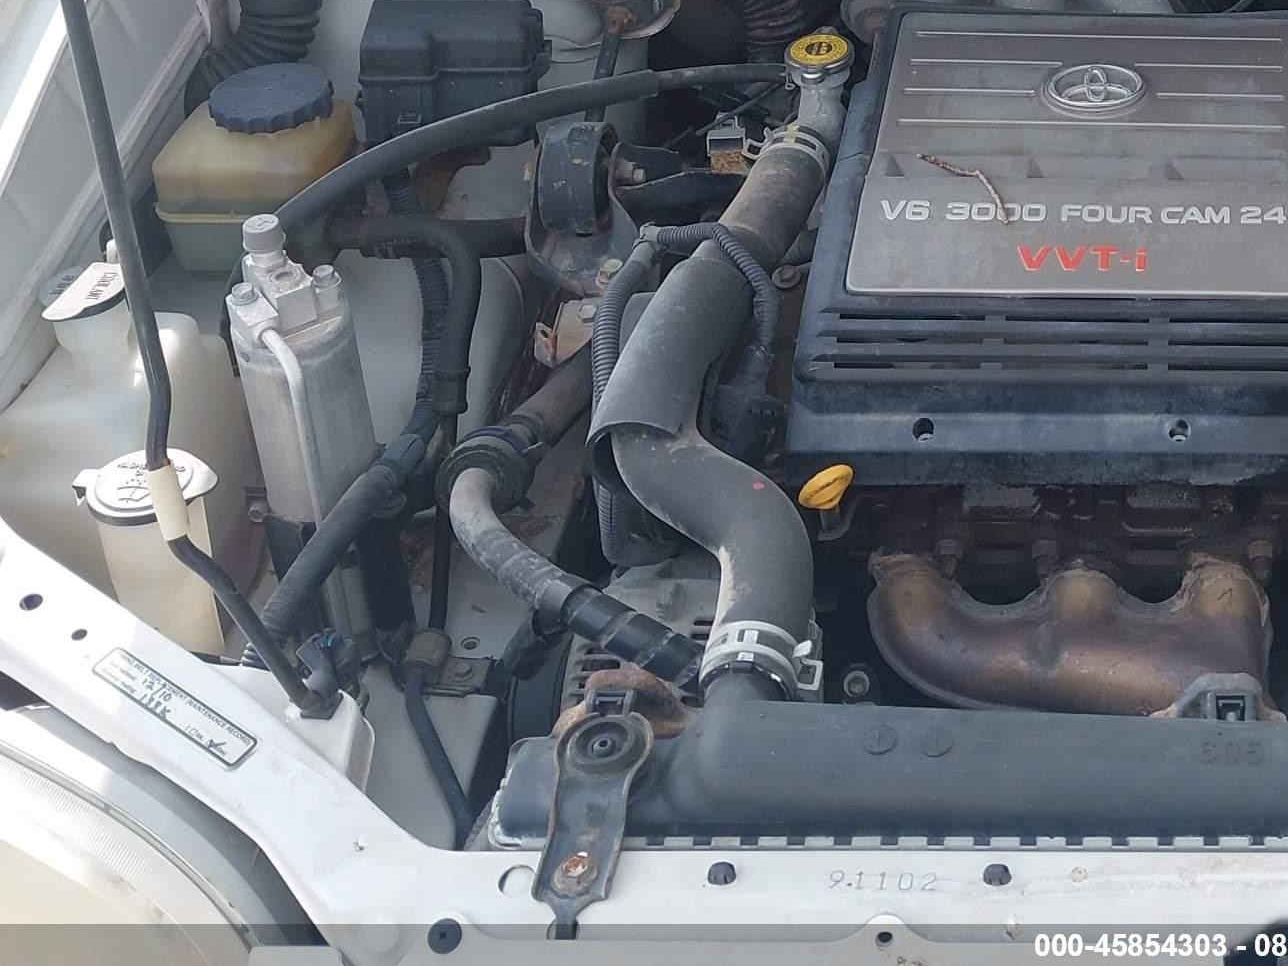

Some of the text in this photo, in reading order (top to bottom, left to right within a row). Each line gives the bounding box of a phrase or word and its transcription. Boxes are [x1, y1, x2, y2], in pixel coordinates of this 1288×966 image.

[881, 199, 1287, 224] V6 3000 FOUR CAM 24
[1016, 244, 1148, 272] VVT-i
